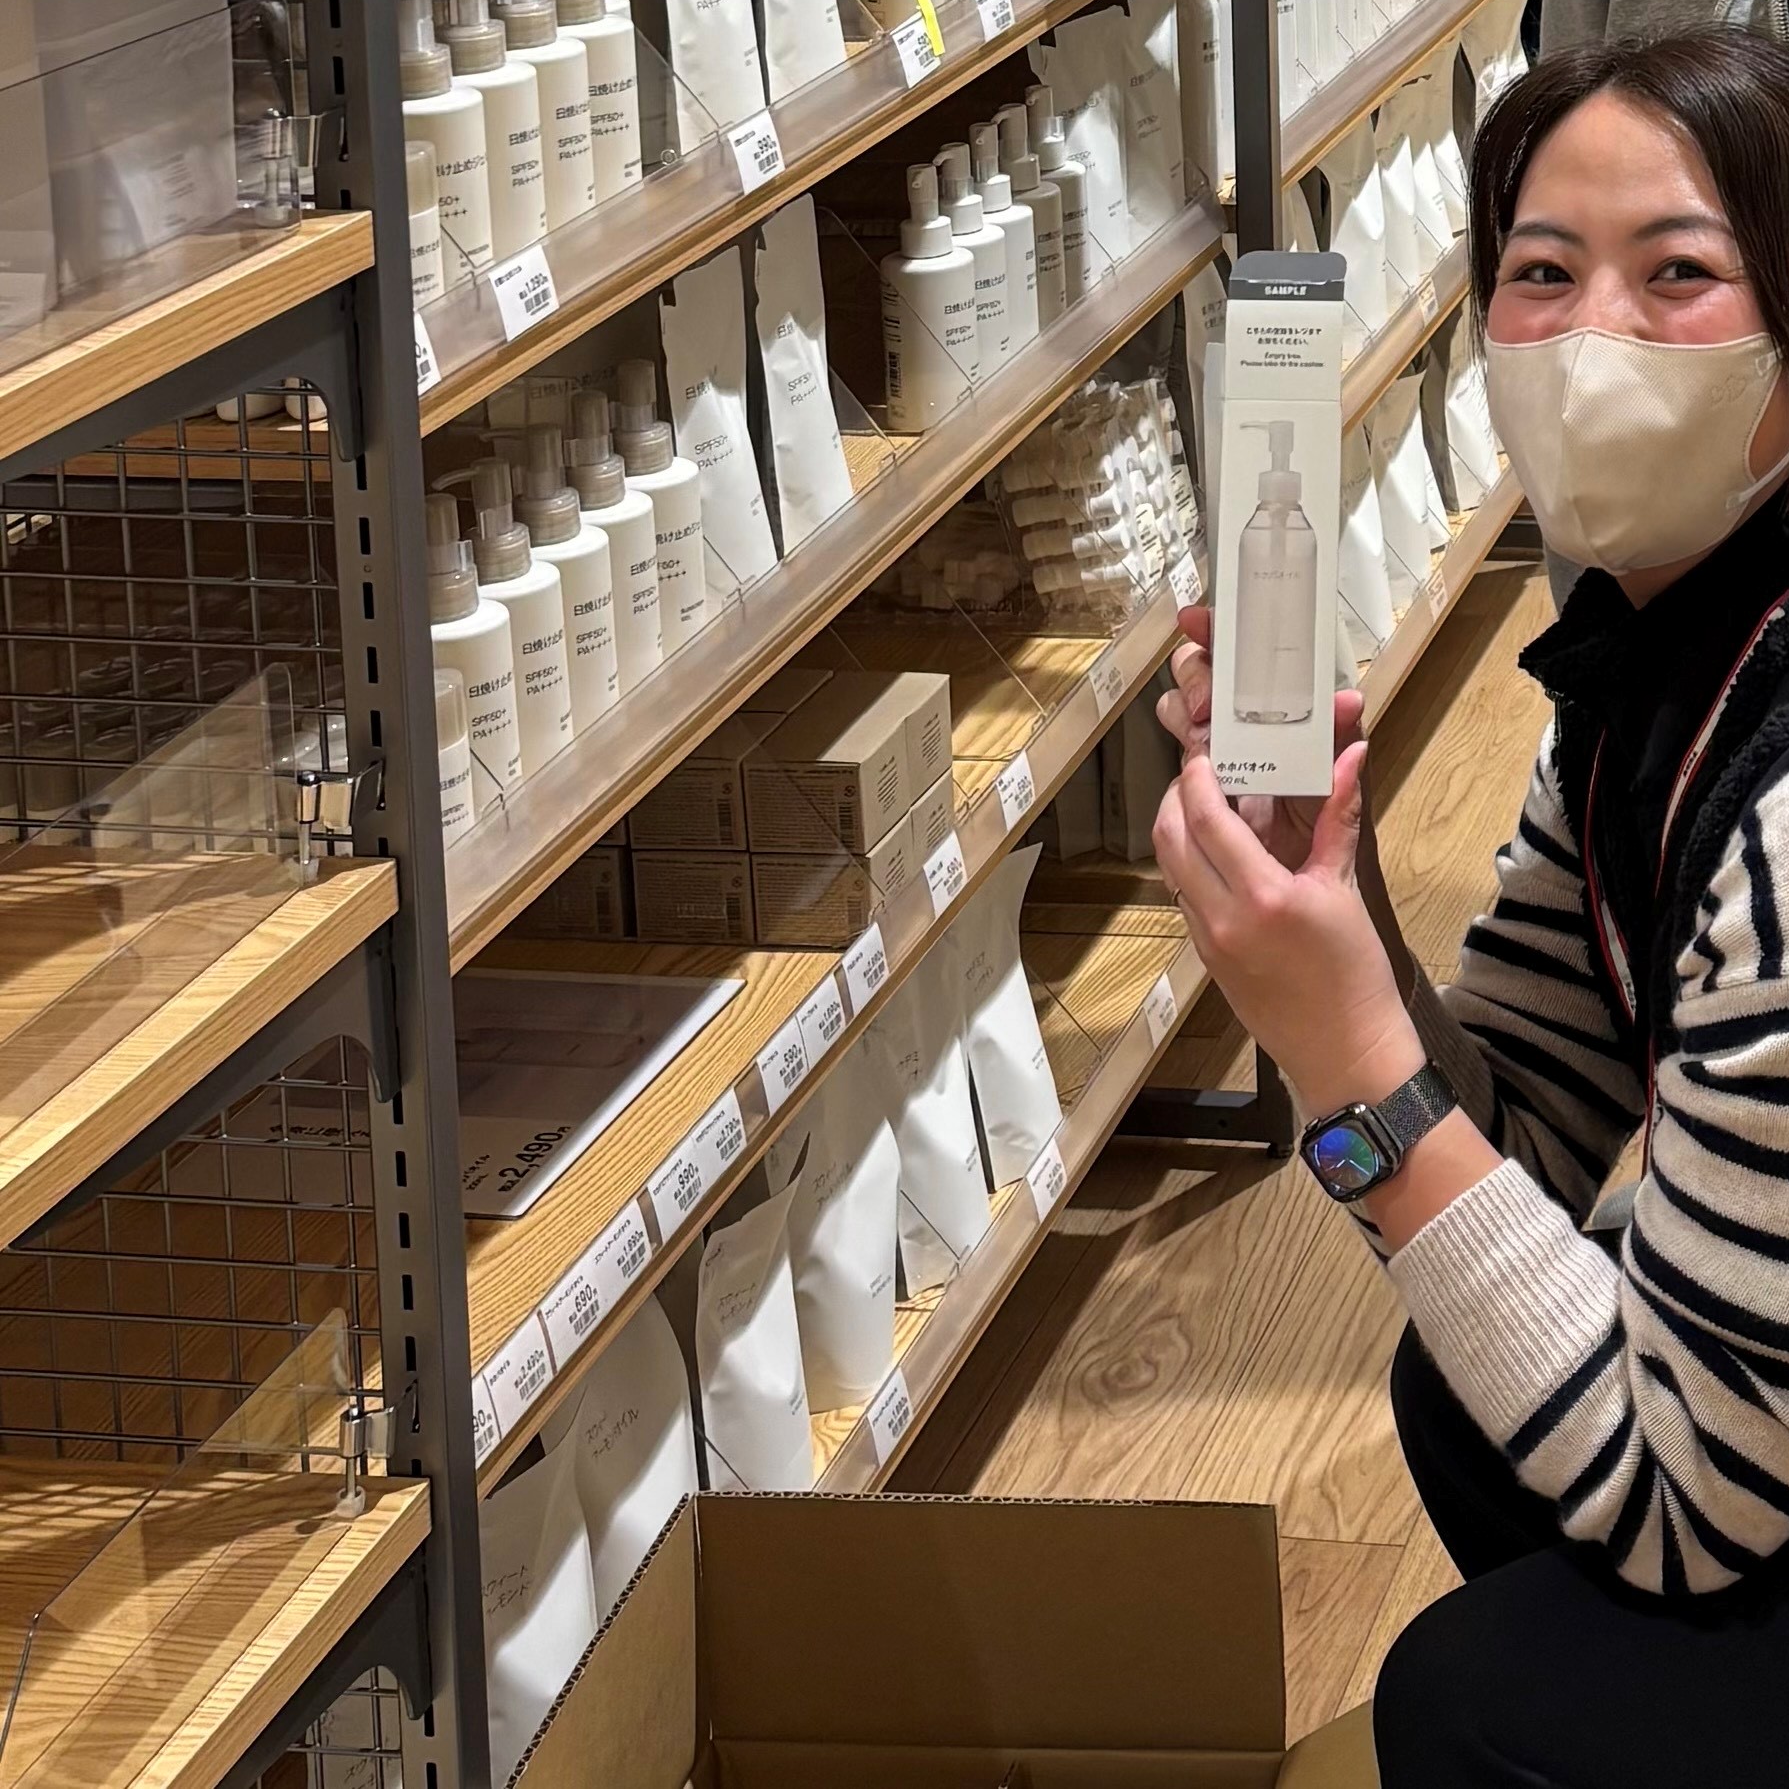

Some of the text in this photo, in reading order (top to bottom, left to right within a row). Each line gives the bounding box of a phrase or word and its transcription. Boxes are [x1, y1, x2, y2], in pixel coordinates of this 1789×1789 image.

[1264, 285, 1308, 296] SAMPLE
[575, 626, 607, 644] SPF50+
[525, 665, 559, 684] SPF50+
[471, 708, 507, 728] SPF50+
[472, 718, 512, 741] PA++++
[1216, 761, 1277, 773] ホホバオイル
